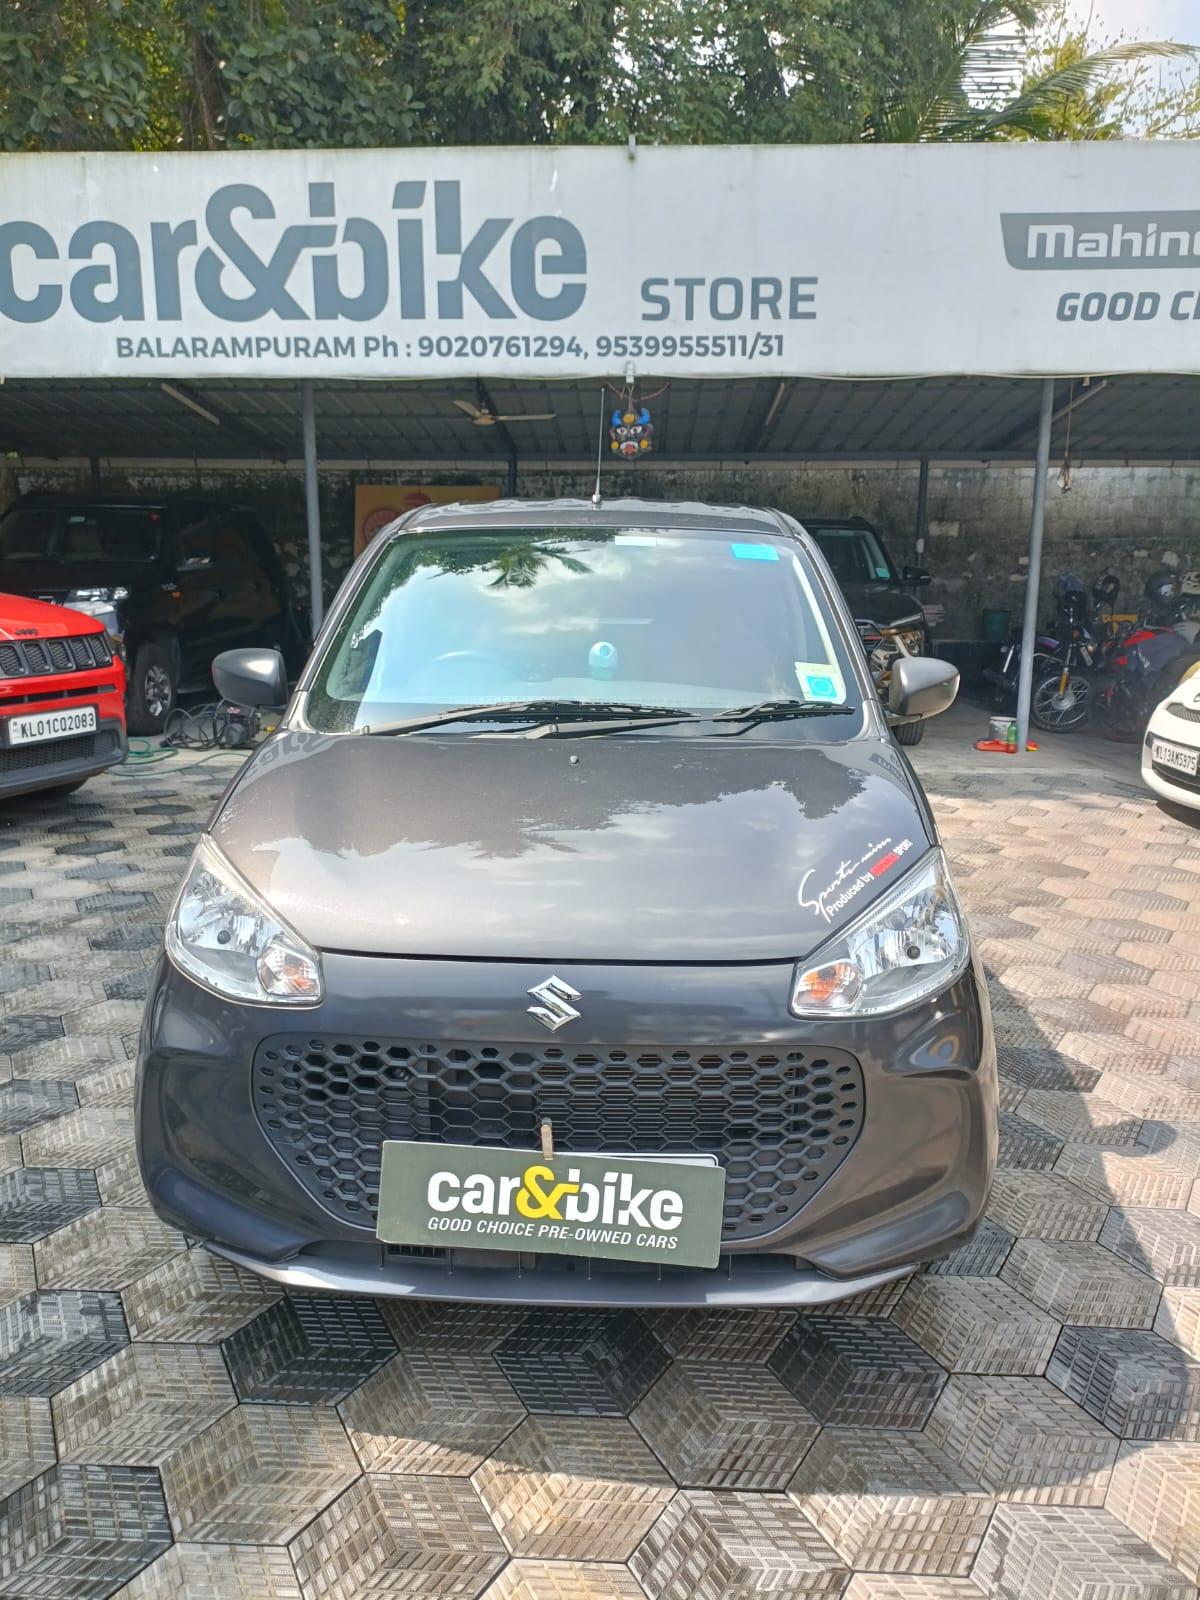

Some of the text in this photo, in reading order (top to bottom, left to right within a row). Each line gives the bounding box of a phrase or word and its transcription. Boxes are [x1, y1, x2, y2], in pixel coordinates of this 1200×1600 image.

[0, 180, 587, 323] car&bike
[1027, 223, 1200, 258] Mahin
[641, 276, 818, 321] STORE
[1056, 291, 1200, 321] GOOD C
[116, 336, 356, 358] BALARAMPURAM
[418, 336, 588, 359] 9020761294,
[595, 332, 784, 359] 9539955511/31
[20, 712, 95, 739] KL01CQ2083
[826, 878, 865, 916] Produced
[860, 871, 875, 884] by
[427, 1165, 684, 1230] car&bike
[427, 1217, 679, 1249] GOOD CHOICE PRE-OWNED CARS
